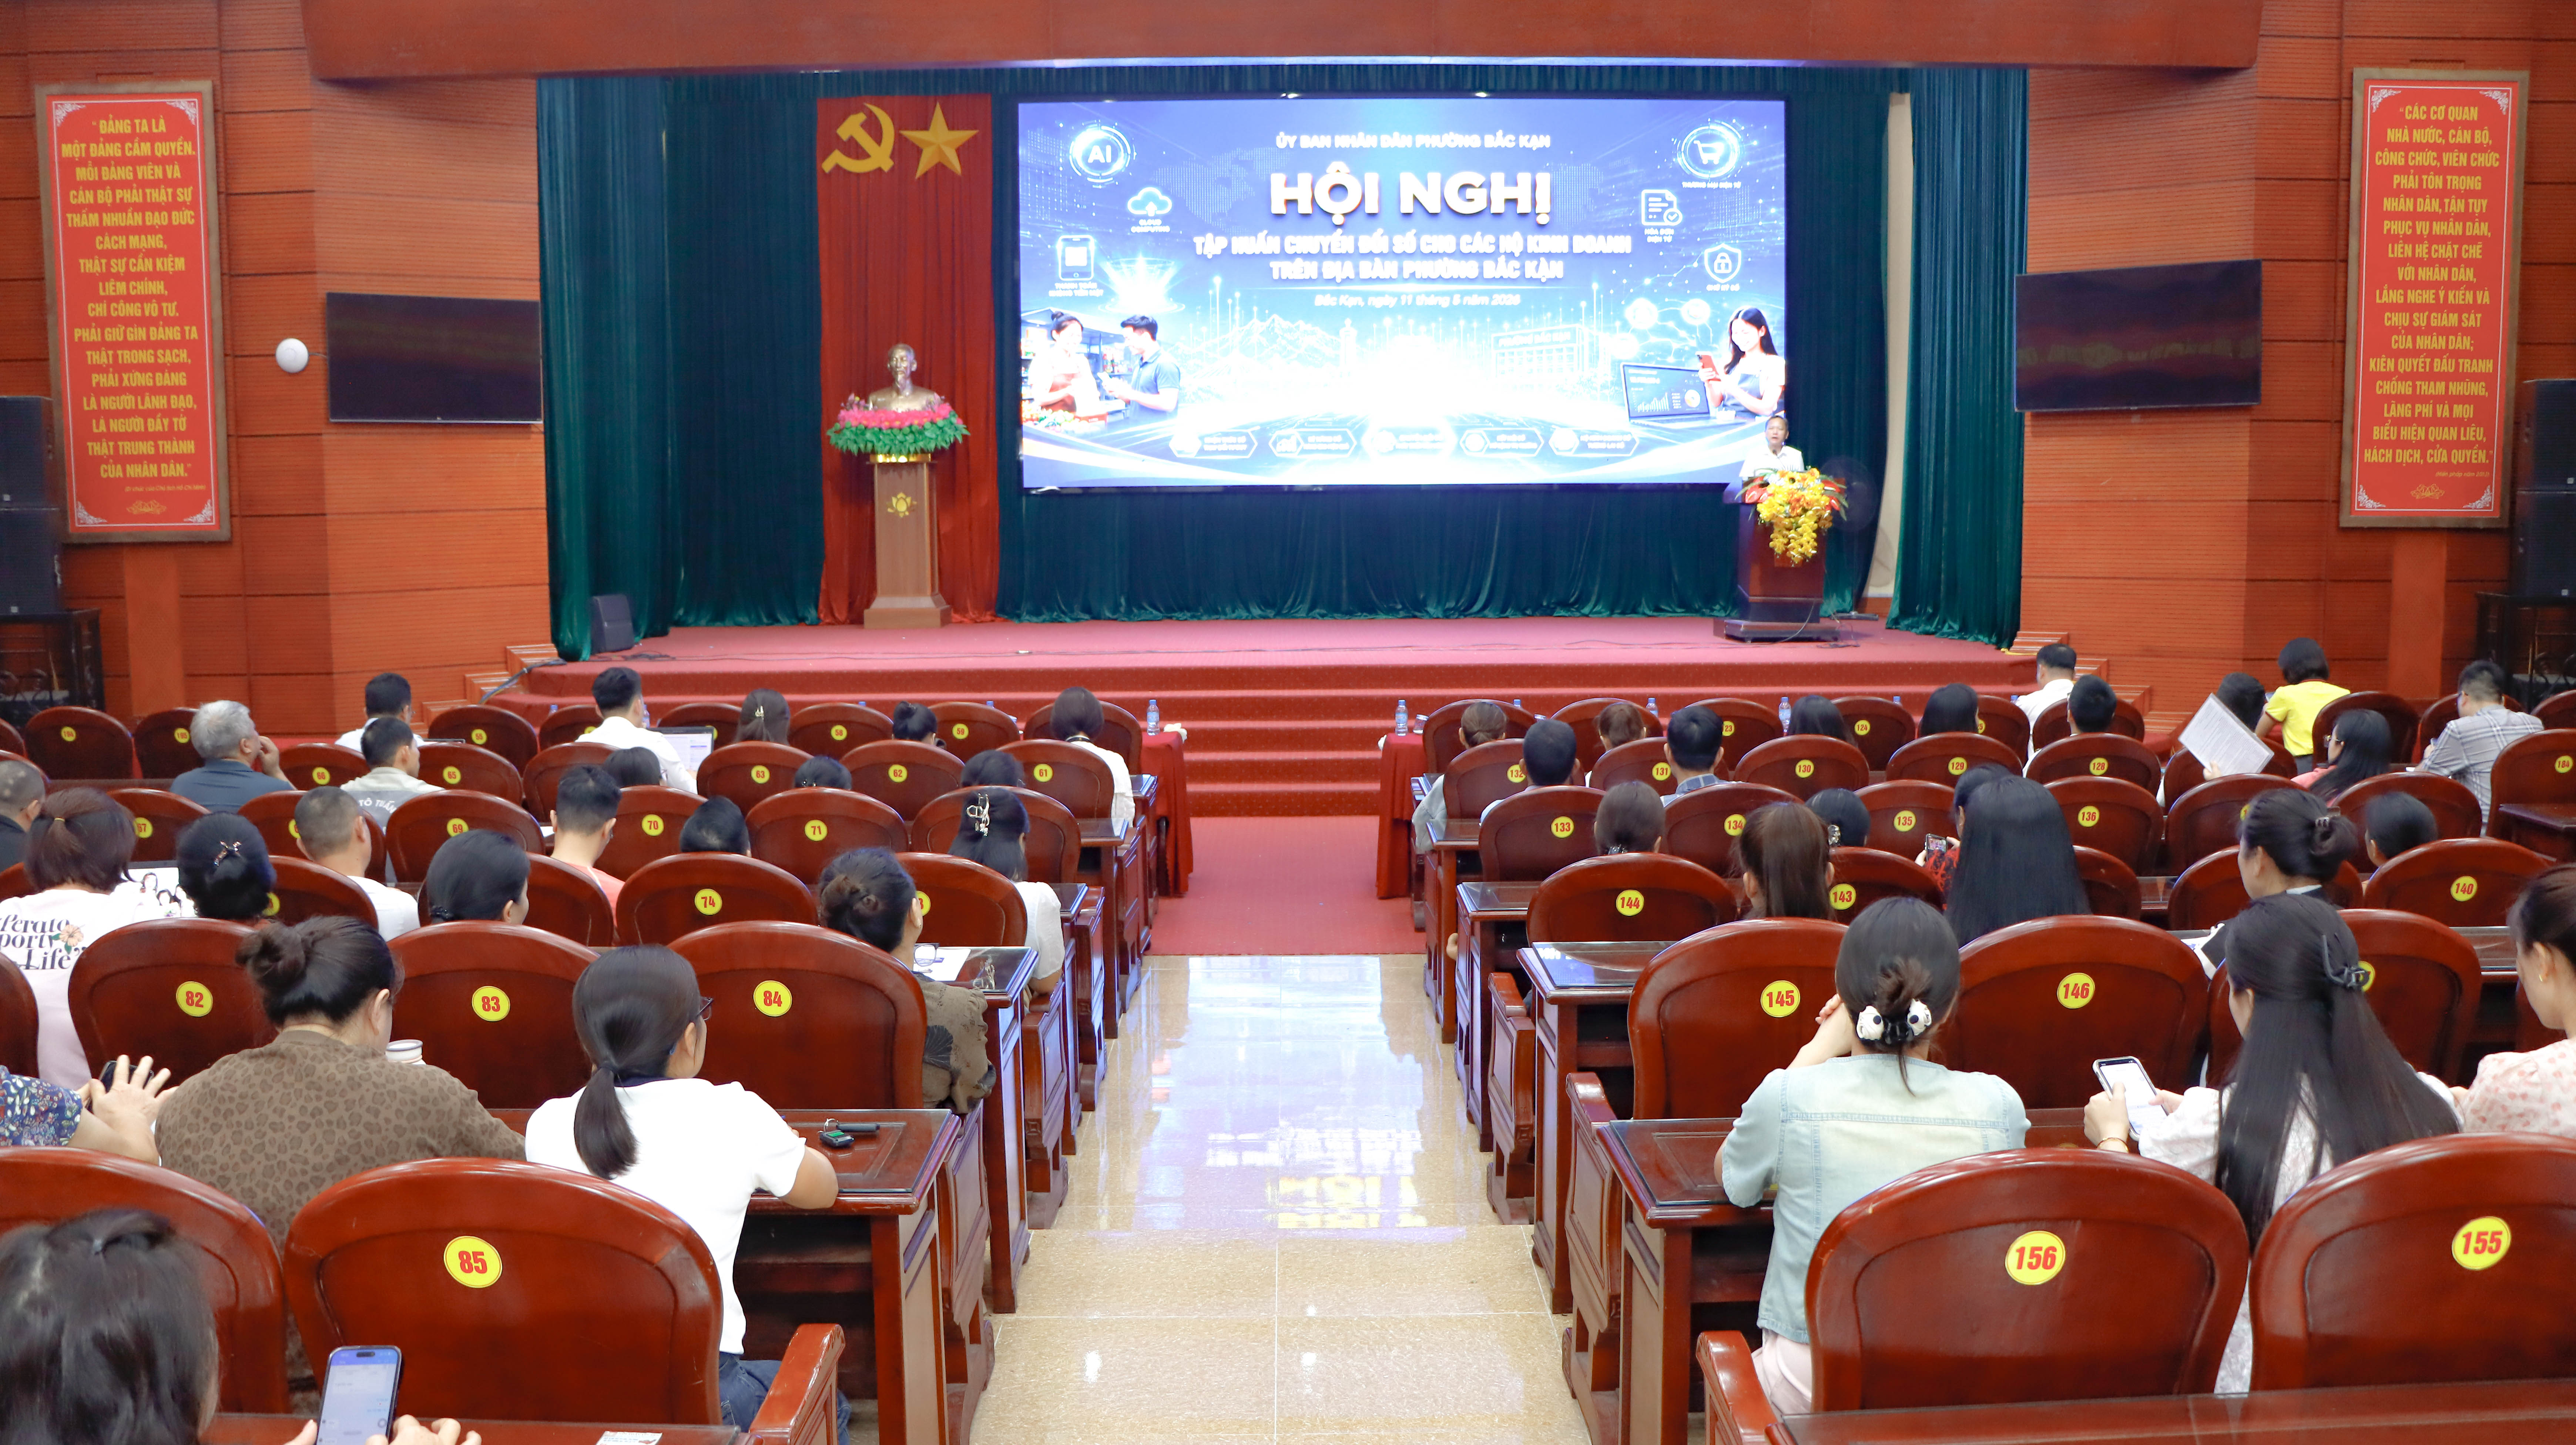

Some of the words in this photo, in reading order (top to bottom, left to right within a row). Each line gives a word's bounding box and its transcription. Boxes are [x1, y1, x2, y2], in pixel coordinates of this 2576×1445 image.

[2430, 105, 2446, 120] CƠ
[2448, 106, 2478, 121] QUAN
[134, 119, 149, 133] TA
[152, 115, 166, 133] LÀ
[1276, 132, 1297, 148] ỦY
[1300, 135, 1331, 148] BAN
[1335, 132, 1377, 148] NHÂN
[1381, 132, 1412, 148] DÂN
[1416, 132, 1481, 148] PHƯỜNG
[1484, 130, 1516, 148] BẮC
[1519, 135, 1551, 151] KẠN
[2387, 125, 2409, 142] NHÀ
[2413, 125, 2445, 144] NƯỚC,
[2449, 127, 2471, 143] CÁN
[2475, 127, 2492, 147] BỘ,
[61, 140, 87, 160] MỘT
[90, 138, 121, 157] ĐẢNG
[125, 137, 151, 156] CẦM
[154, 136, 195, 157] QUYỀN.
[1088, 145, 1111, 164] AI
[2375, 148, 2405, 165] CÔNG
[2408, 149, 2440, 167] CHỨC,
[2443, 150, 2467, 166] VIÊN
[2471, 150, 2499, 167] CHỨC
[76, 161, 98, 181] MỖI
[101, 161, 133, 180] ĐẢNG
[136, 162, 163, 179] VIÊN
[166, 161, 181, 178] VÀ
[2394, 170, 2418, 188] PHẢI
[2422, 172, 2443, 189] TÔN
[2446, 175, 2481, 192] TRỌNG
[70, 187, 94, 204] CÁN
[97, 187, 113, 206] BỘ
[115, 184, 142, 203] PHẢI
[145, 185, 173, 205] THẬT
[177, 187, 193, 204] SỰ
[1270, 161, 1379, 225] HỘI
[1399, 171, 1552, 225] NGHỊ
[2384, 194, 2414, 211] NHÂN
[2417, 195, 2442, 213] DÂN,
[2444, 195, 2465, 215] TẬN
[2468, 199, 2487, 215] TỤY
[66, 208, 99, 227] THẤM
[145, 211, 168, 228] ĐẠO
[172, 207, 195, 225] ĐỨC
[2384, 220, 2412, 237] PHỤC
[2416, 221, 2429, 238] VỤ
[2432, 218, 2462, 235] NHÂN
[2466, 219, 2491, 237] DÂN,
[96, 233, 126, 249] CÁCH
[129, 234, 167, 252] MẠNG,
[1193, 232, 1228, 259] TẬP
[1358, 228, 1389, 254] ĐỔI
[1393, 229, 1417, 254] SỐ
[1420, 235, 1456, 254] CHO
[1460, 231, 1495, 254] CÁC
[1499, 231, 1523, 257] HỘ
[1527, 235, 1569, 254] KINH
[1573, 235, 1631, 253] DOANH
[2389, 240, 2412, 258] LIÊN
[2415, 241, 2429, 261] HỆ
[2431, 242, 2459, 261] CHẶT
[2462, 242, 2482, 258] CHẼ
[1269, 258, 1318, 279] TRÊN
[1322, 261, 1355, 283] ĐỊA
[1359, 257, 1398, 279] BÀN
[1403, 257, 1479, 279] PHƯỜNG
[1483, 255, 1520, 279] BẮC
[2398, 263, 2415, 281] VỚI
[2418, 264, 2448, 281] NHÂN
[2452, 264, 2476, 283] DÂN,
[99, 278, 127, 295] LIÊM
[129, 278, 168, 295] CHÍNH,
[1401, 294, 1412, 306] 11
[2369, 355, 2394, 371] KIÊN
[2398, 353, 2431, 373] QUYẾT
[2434, 353, 2455, 372] ĐẤU
[2458, 359, 2493, 372] TRANH
[2373, 420, 2397, 440] BIỂU
[2401, 423, 2425, 443] HIỆN
[2429, 427, 2457, 441] QUAN
[2461, 424, 2486, 441] LIÊU,
[87, 439, 114, 457] THẬT
[118, 441, 154, 455] TRUNG
[158, 438, 195, 454] THÀNH
[2364, 446, 2392, 462] HÁCH
[2396, 449, 2423, 466] DỊCH,
[2427, 444, 2448, 463] CỬA
[101, 460, 123, 477] CỦA
[126, 461, 157, 477] NHÂN
[1511, 770, 1523, 778] 132
[358, 797, 372, 807] TÔ
[648, 821, 658, 830] 70
[1728, 821, 1743, 829] 134
[1898, 817, 1912, 826] 135
[2082, 812, 2096, 821] 136
[453, 824, 463, 833] 69
[811, 826, 821, 835] 71
[1555, 822, 1571, 832] 133
[1833, 891, 1852, 902] 143
[2456, 883, 2474, 895] 140
[701, 896, 715, 908] 74
[1621, 897, 1640, 909] 144
[0, 933, 54, 955] porty
[186, 990, 204, 1008] 82
[764, 990, 782, 1007] 84
[1767, 990, 1795, 1008] 145
[2063, 983, 2090, 999] 146
[482, 996, 501, 1012] 83
[2463, 1231, 2503, 1255] 155
[458, 1251, 487, 1274] 85
[2016, 1246, 2057, 1270] 156
